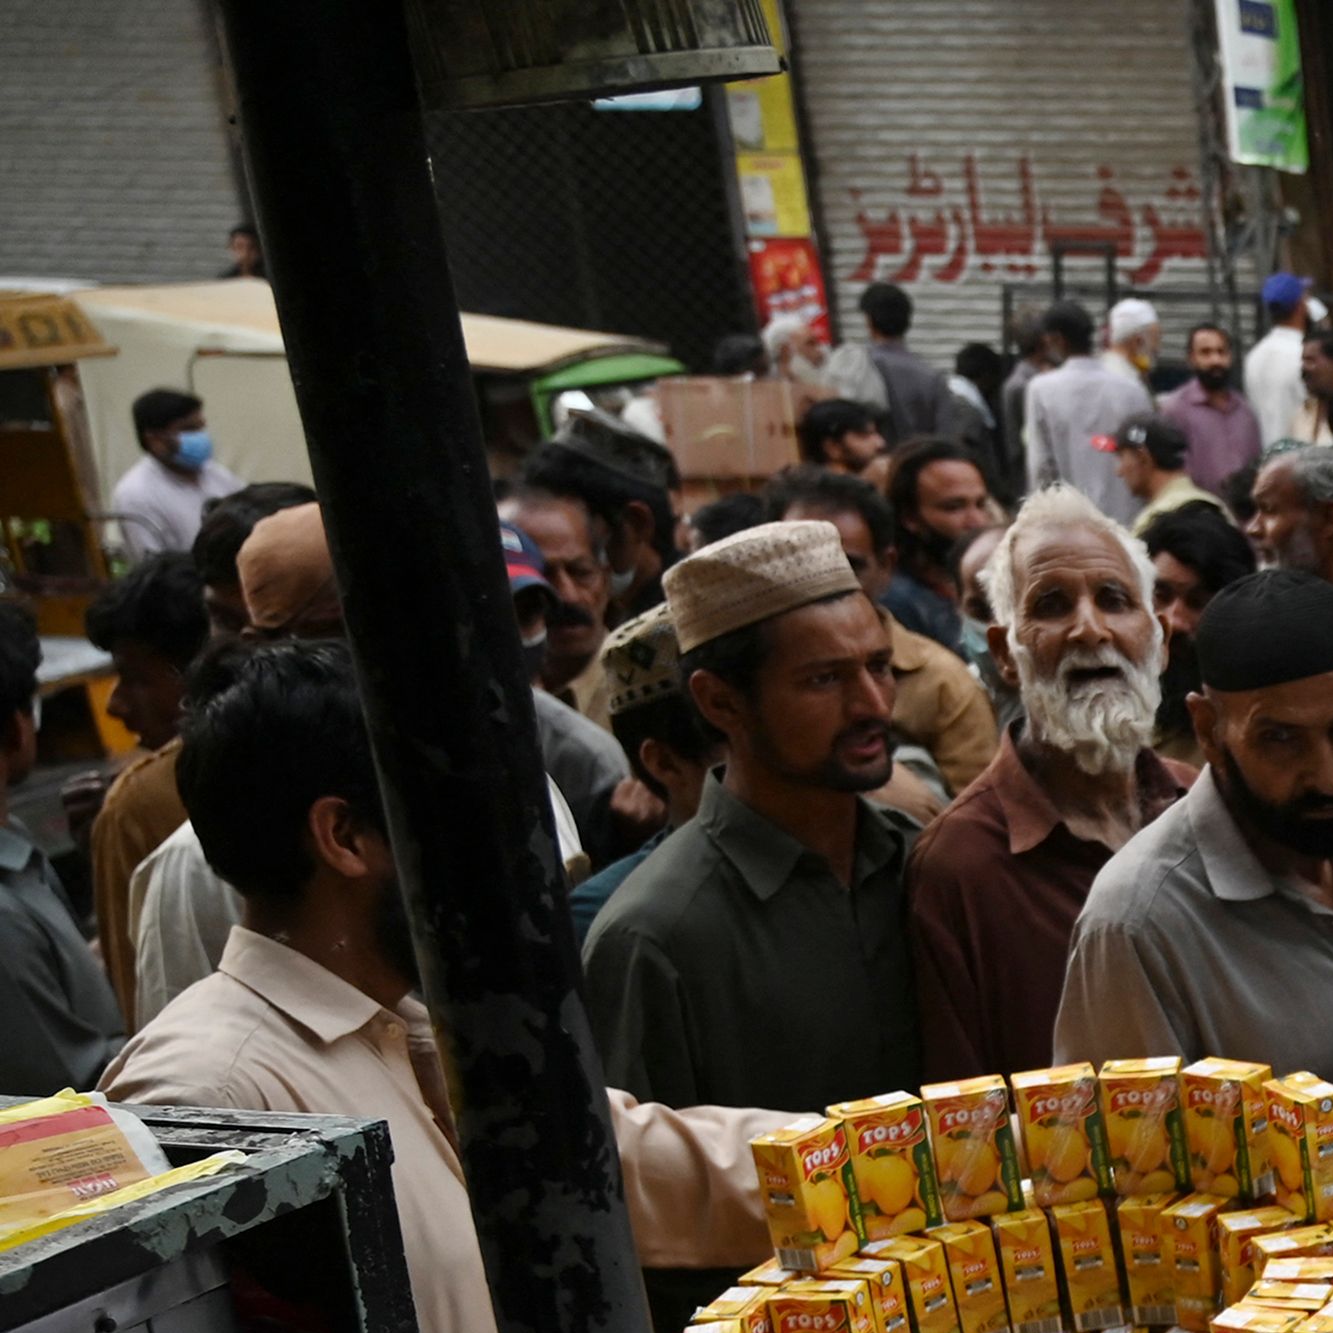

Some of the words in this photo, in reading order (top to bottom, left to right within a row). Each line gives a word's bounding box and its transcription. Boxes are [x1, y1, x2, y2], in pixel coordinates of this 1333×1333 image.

[1041, 161, 1210, 285] شرف
[1034, 1095, 1084, 1115] TOPS
[1116, 1088, 1169, 1106] TOPS
[943, 1104, 995, 1127] TOPS
[1271, 1103, 1299, 1127] TOPS
[861, 1120, 913, 1145] TOPS
[803, 1141, 841, 1168] TOPS
[786, 1312, 837, 1330] TOPS
